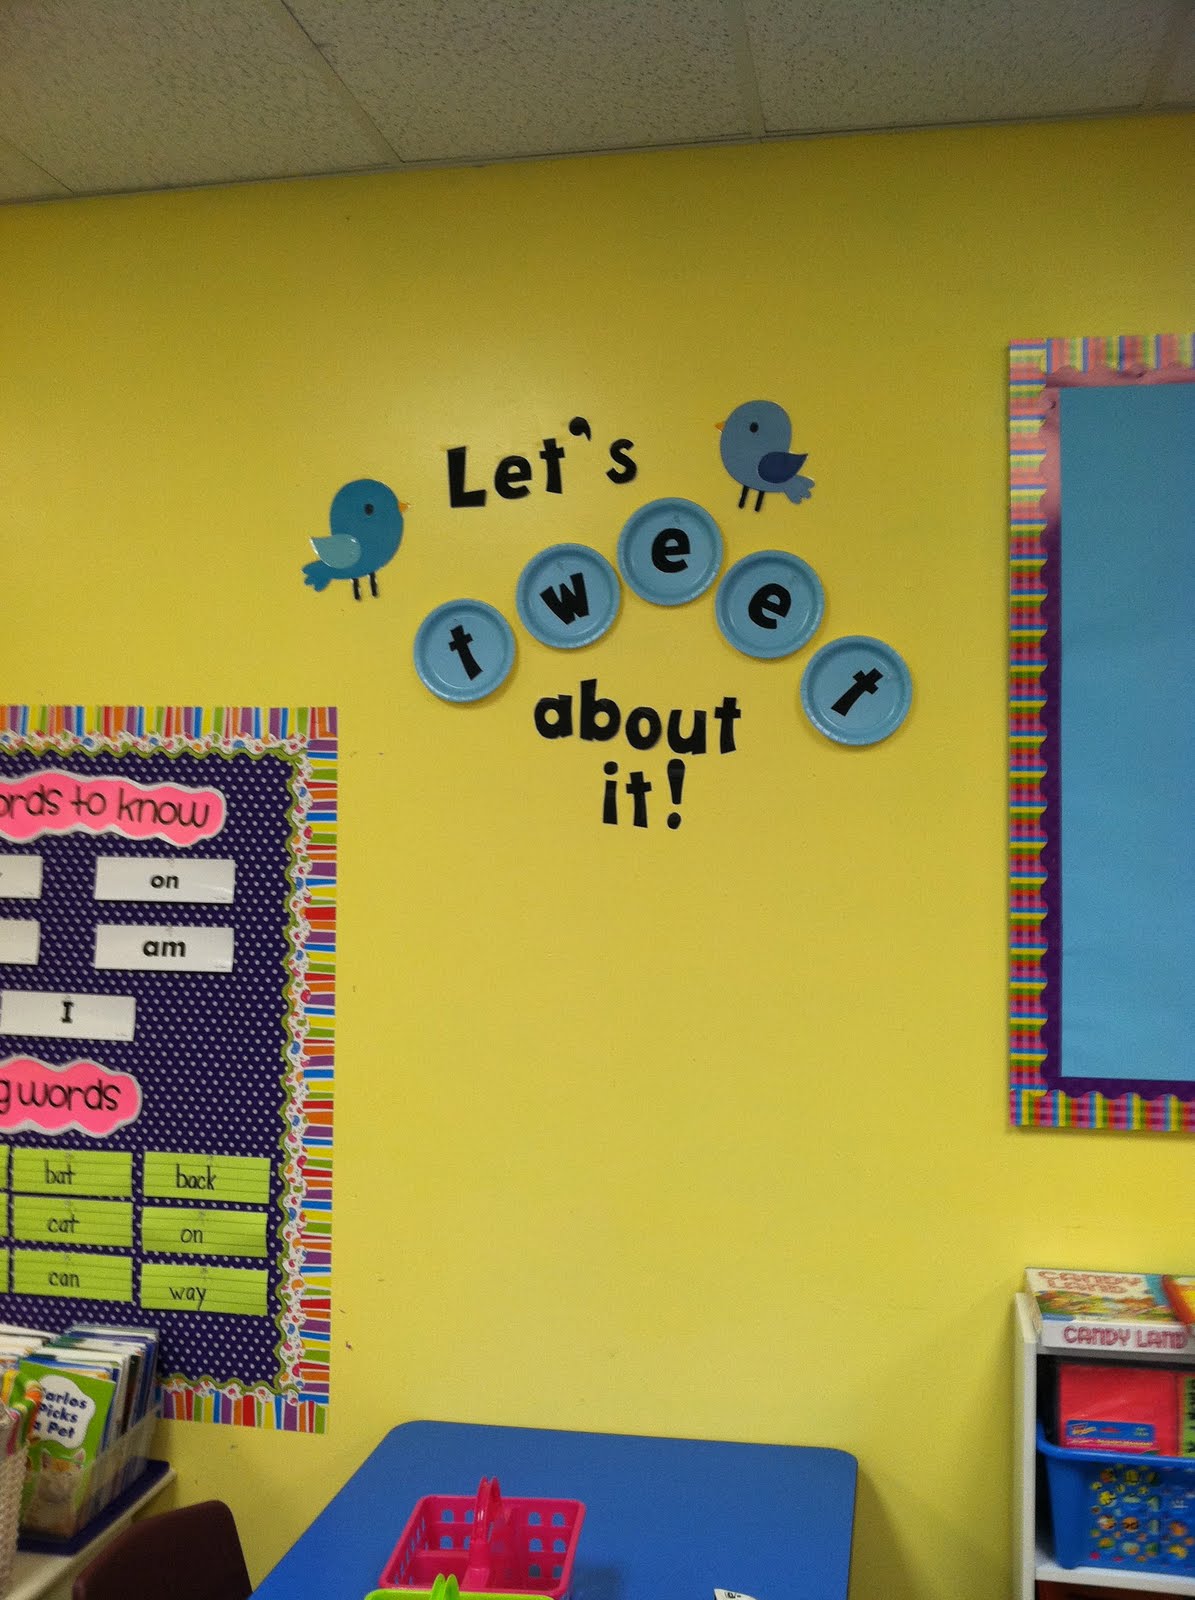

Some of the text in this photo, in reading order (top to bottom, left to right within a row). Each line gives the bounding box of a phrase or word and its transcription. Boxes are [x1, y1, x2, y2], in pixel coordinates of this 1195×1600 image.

[447, 416, 637, 508] Let's
[534, 678, 742, 755] about
[70, 784, 107, 817] to
[117, 788, 210, 828] know
[602, 758, 686, 830] it!
[150, 874, 180, 890] on
[142, 940, 187, 958] am
[60, 1000, 75, 1024] I
[18, 1079, 122, 1112] words
[43, 1159, 76, 1186] bat
[176, 1163, 217, 1191] back
[47, 1211, 80, 1234] cat
[180, 1228, 204, 1244] on
[49, 1270, 81, 1288] can
[169, 1286, 207, 1311] way
[1063, 1325, 1189, 1350] CANDY LAND
[42, 1388, 88, 1410] arlos
[47, 1421, 76, 1439] Pet
